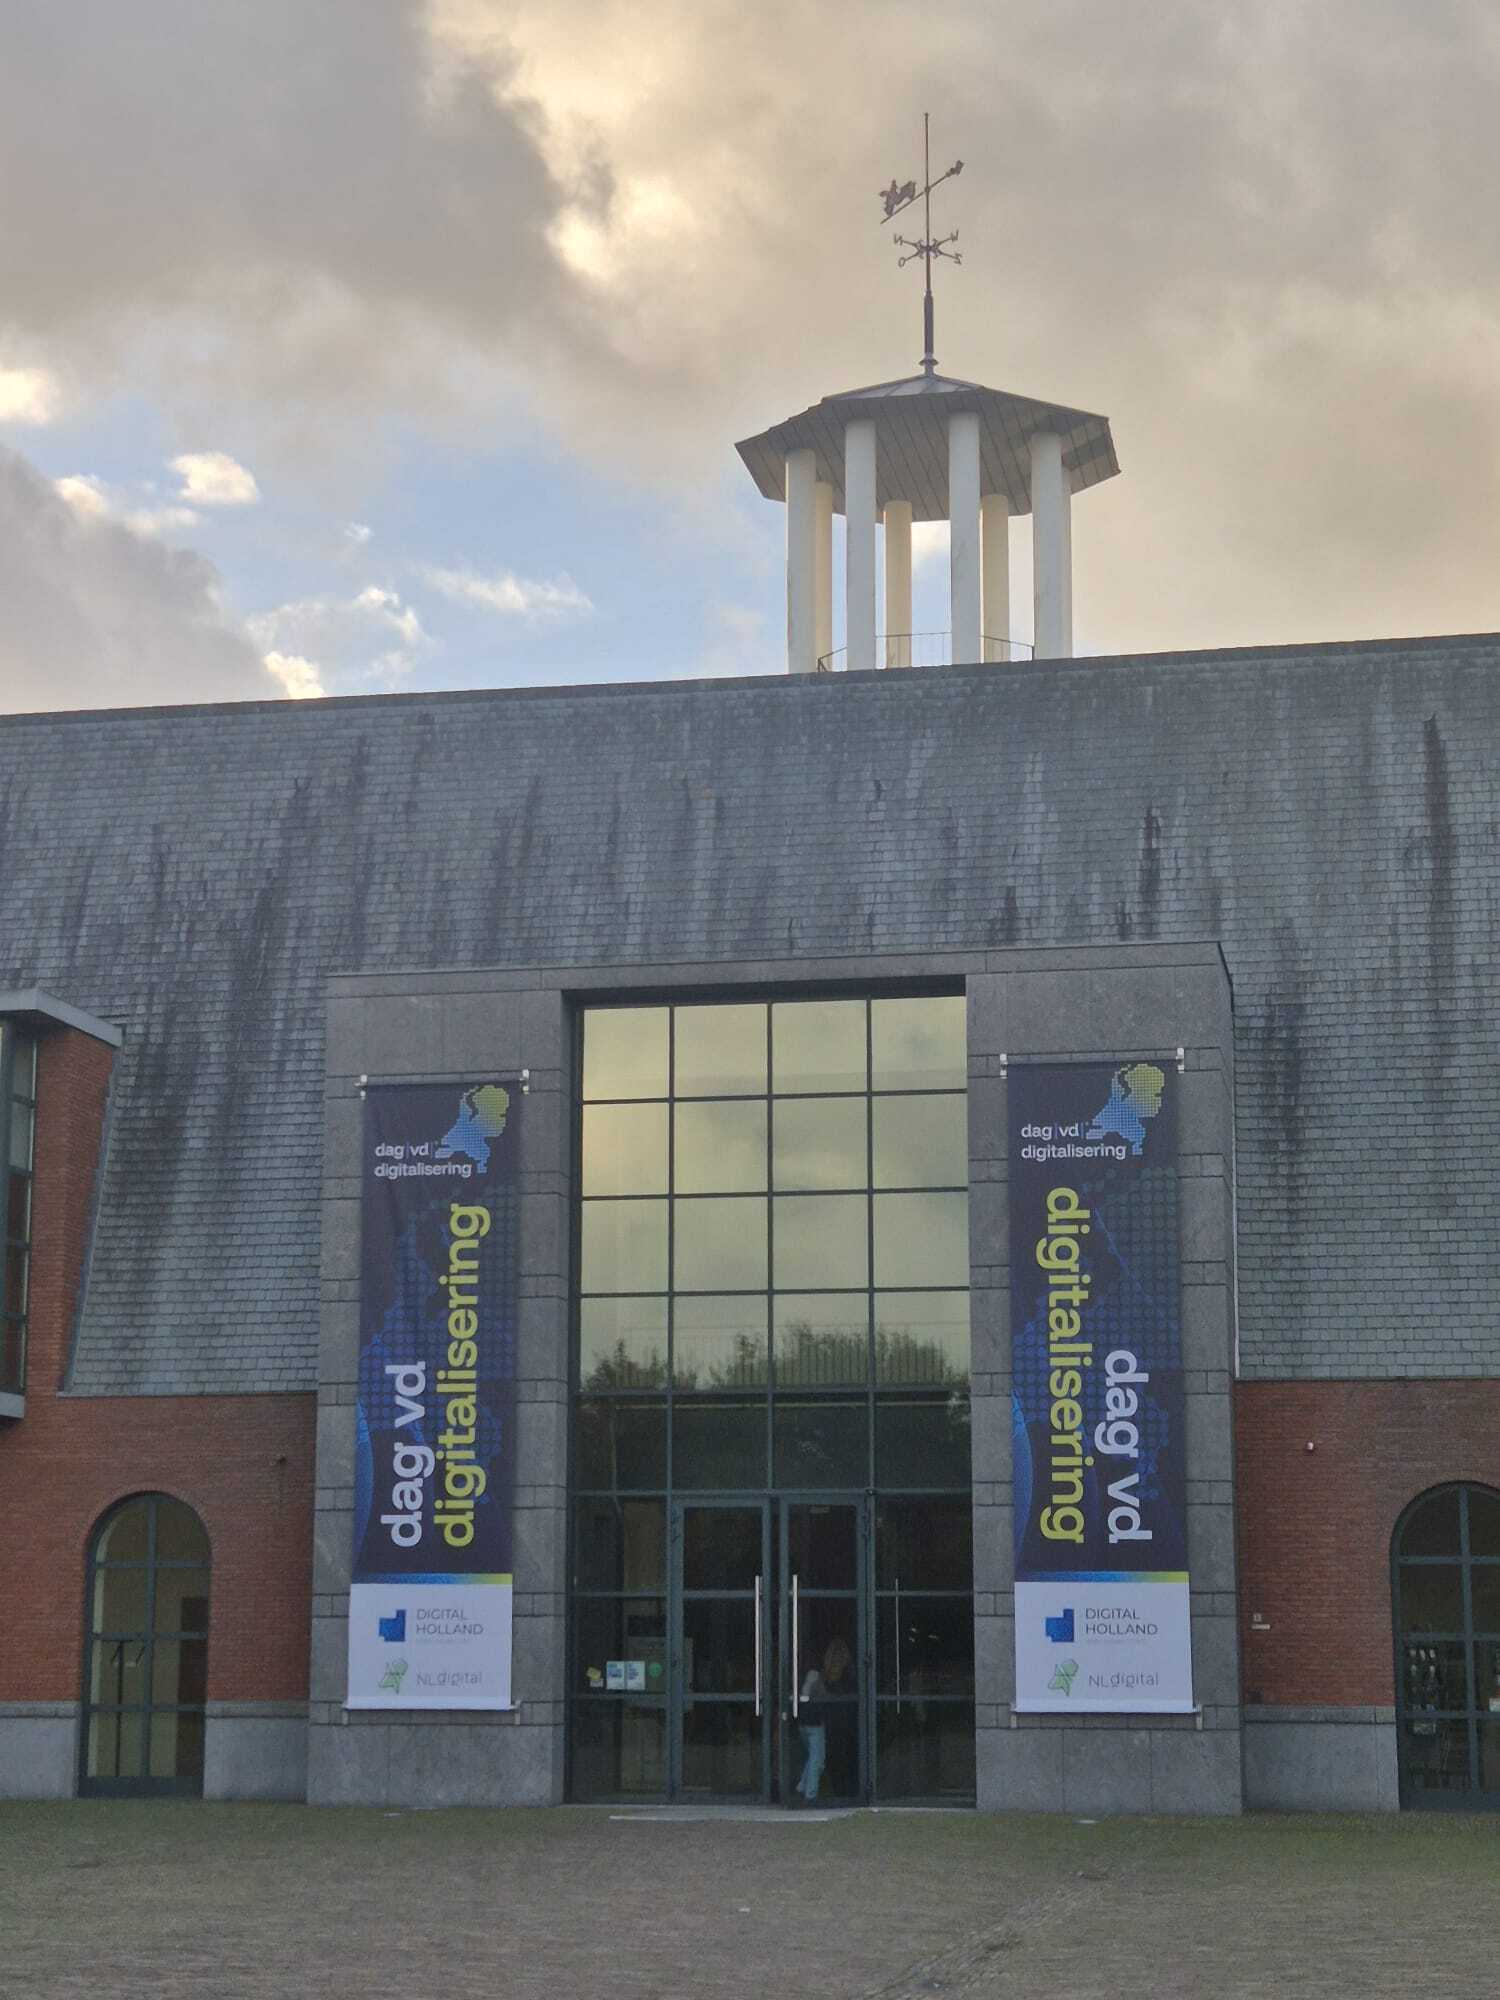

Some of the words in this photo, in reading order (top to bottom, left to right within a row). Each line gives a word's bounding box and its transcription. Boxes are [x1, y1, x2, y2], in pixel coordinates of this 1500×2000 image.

[1021, 1123, 1052, 1140] dag
[1058, 1123, 1079, 1137] vd
[374, 1142, 404, 1159] dag
[409, 1142, 429, 1156] vd
[1021, 1144, 1126, 1162] digitalisering
[374, 1161, 472, 1179] digitalisering
[1035, 1187, 1095, 1544] digitalisering
[433, 1203, 491, 1547] digitalisering
[384, 1361, 426, 1428] vd
[1094, 1350, 1149, 1458] dag
[380, 1442, 436, 1547] dag
[1107, 1472, 1152, 1544] vd
[416, 1608, 469, 1621] DIGITAL
[1085, 1607, 1140, 1620] DIGITAL
[416, 1623, 484, 1636] HOLLAND
[1085, 1623, 1159, 1636] HOLLAND
